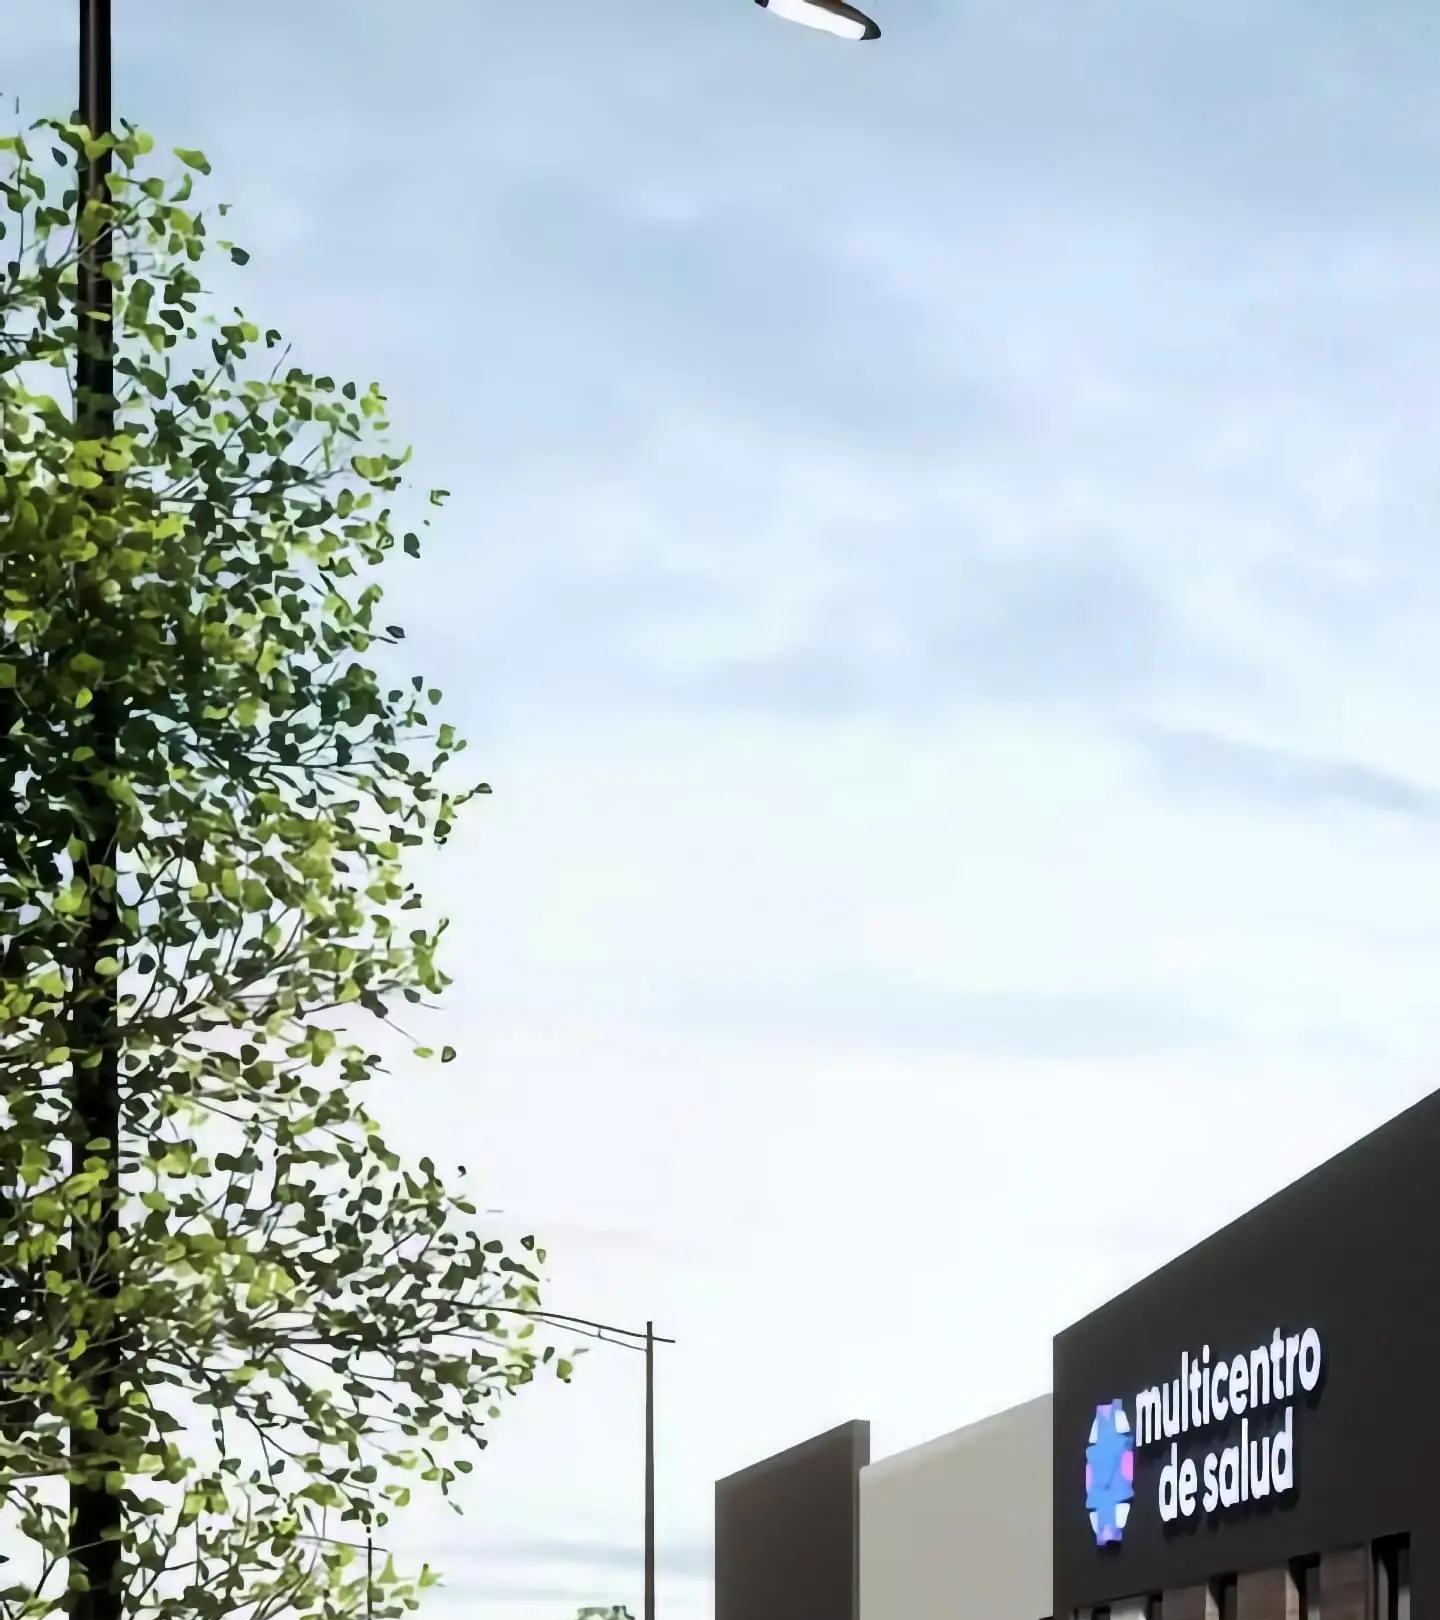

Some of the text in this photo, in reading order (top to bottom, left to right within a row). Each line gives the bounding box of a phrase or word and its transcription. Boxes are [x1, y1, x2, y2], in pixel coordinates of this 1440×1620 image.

[1136, 1327, 1321, 1447] multicentro
[1158, 1406, 1294, 1522] de salud
